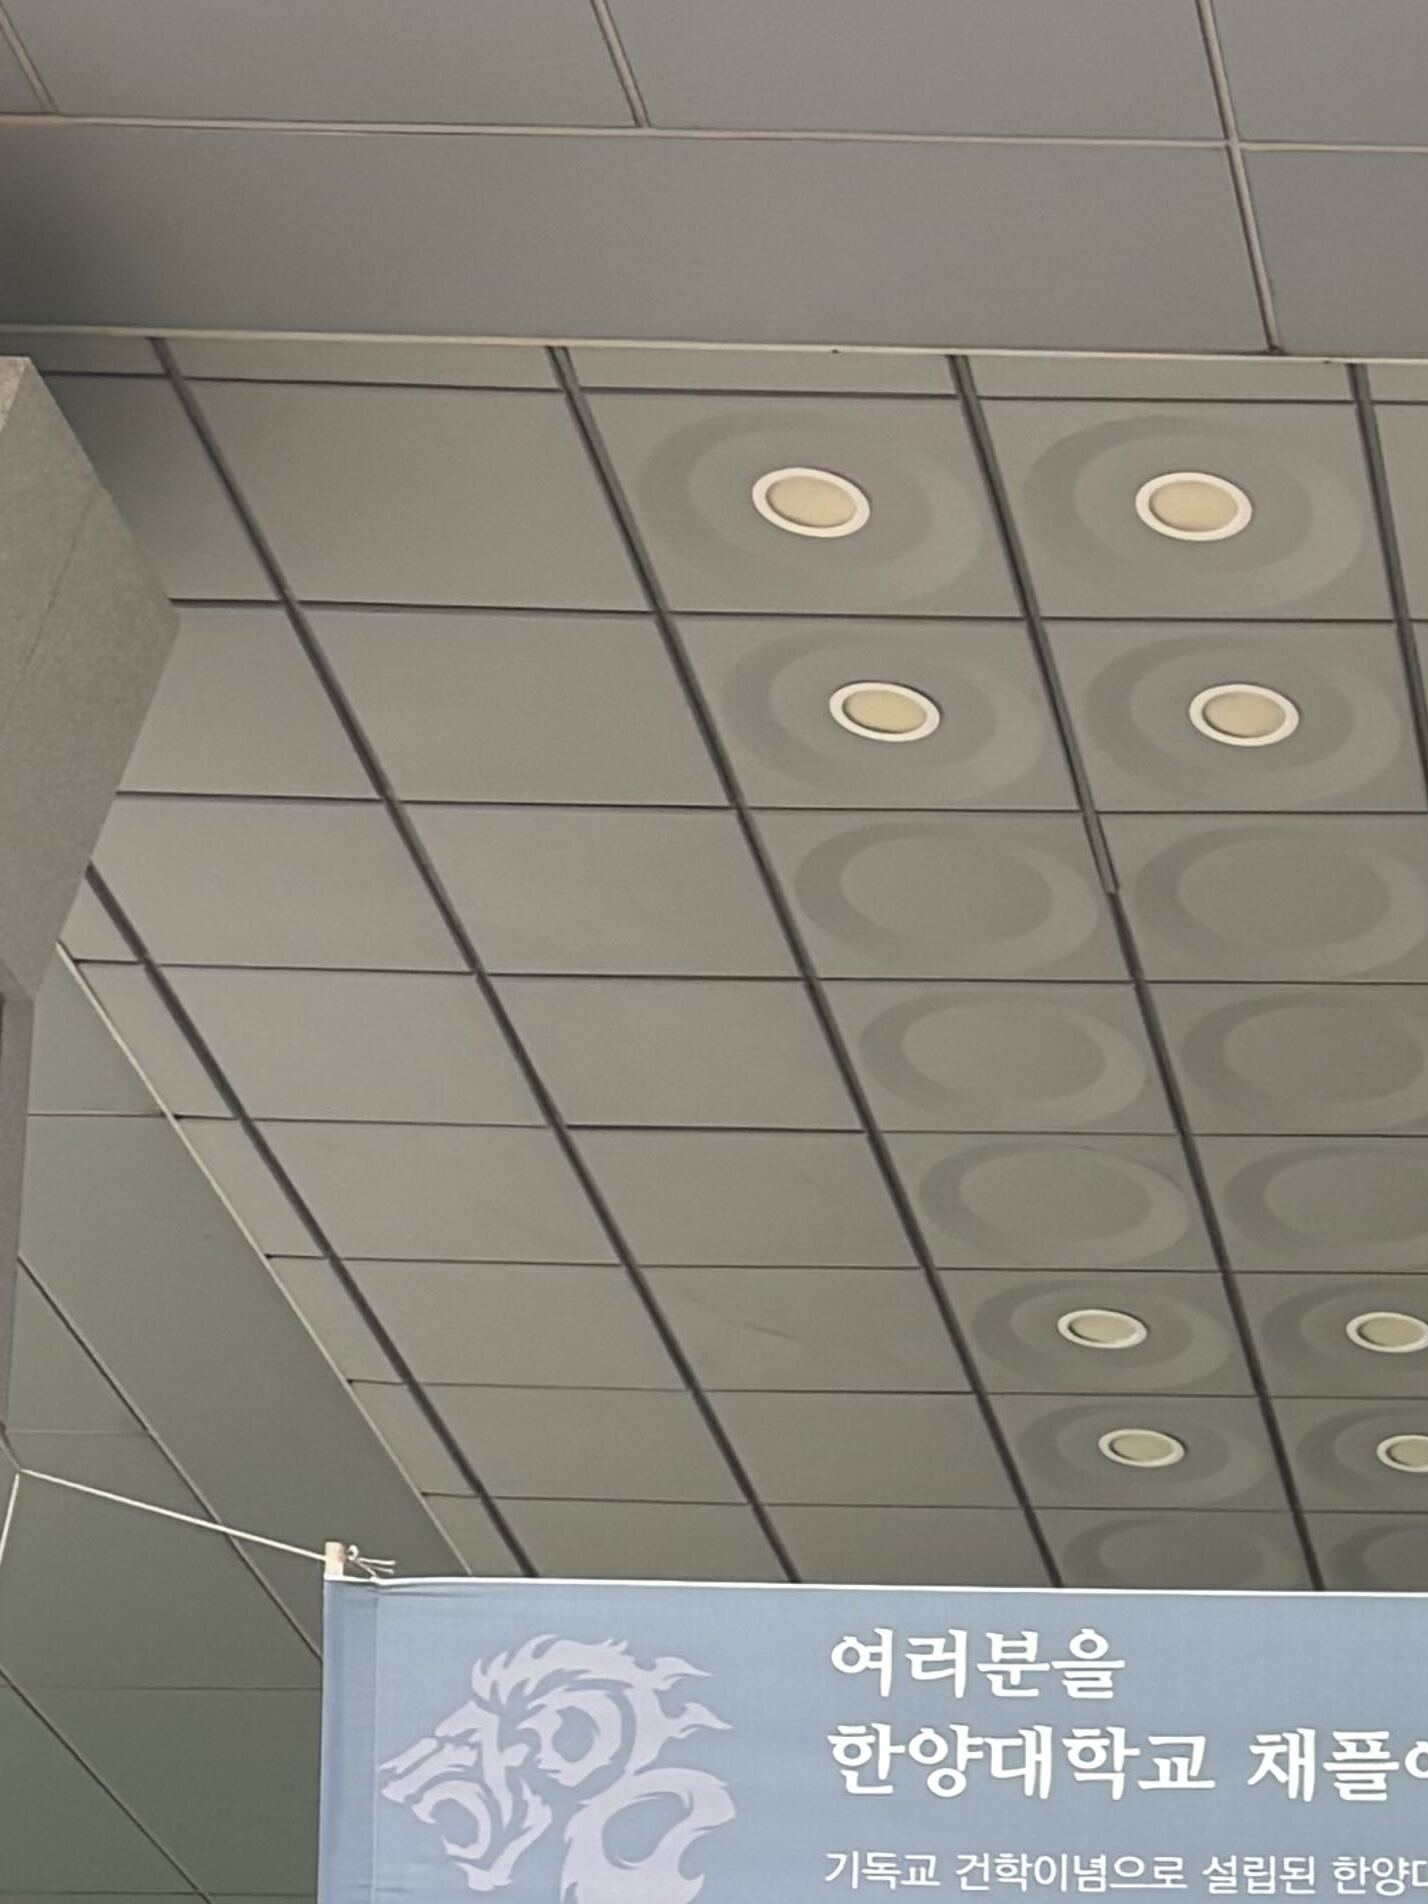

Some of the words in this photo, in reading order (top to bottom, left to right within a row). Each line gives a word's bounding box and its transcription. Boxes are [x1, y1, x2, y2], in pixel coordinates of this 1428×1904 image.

[831, 1627, 1126, 1699] 여러분을
[827, 1722, 1216, 1801] 한양대학교
[825, 1850, 941, 1890] 기독교
[955, 1852, 1188, 1893] 건학이념으로
[1201, 1854, 1316, 1895] 설립된
